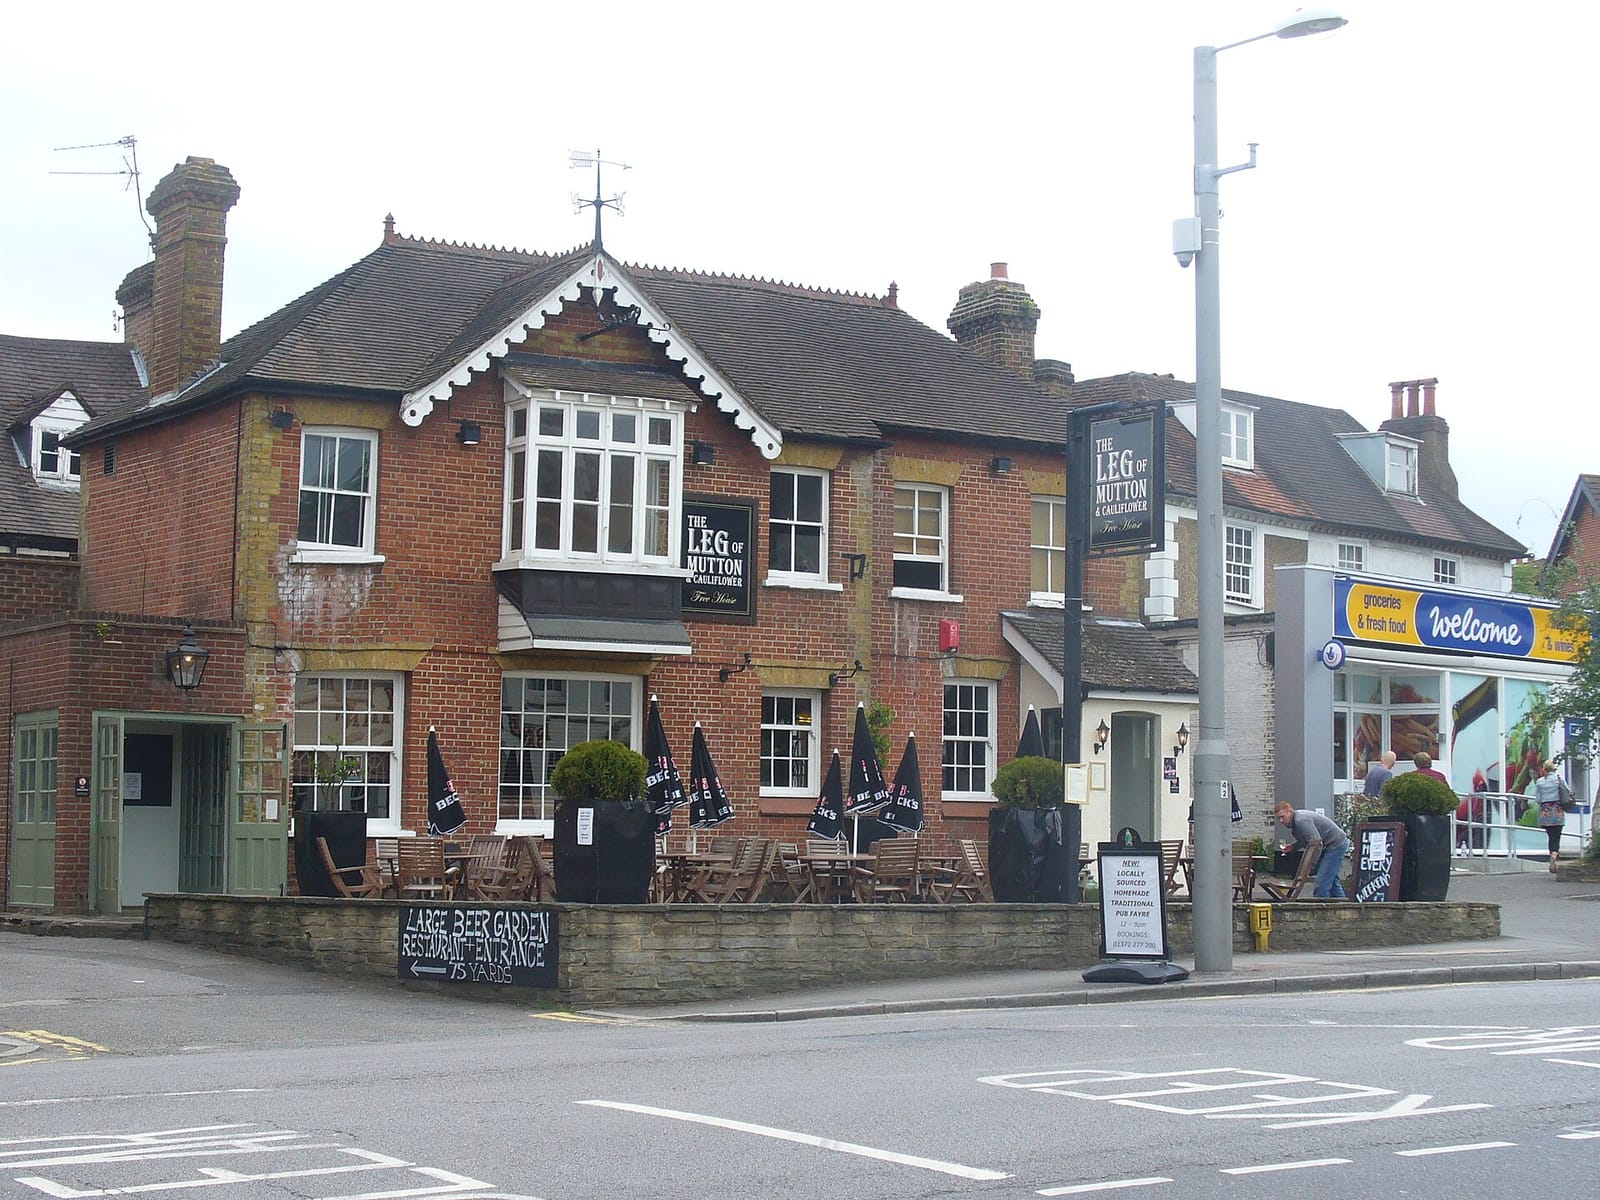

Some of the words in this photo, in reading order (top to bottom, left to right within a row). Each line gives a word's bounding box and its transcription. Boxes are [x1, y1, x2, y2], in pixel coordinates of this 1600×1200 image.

[1096, 437, 1113, 453] THE
[1096, 449, 1134, 483] LEG
[1136, 458, 1148, 473] OF
[1095, 478, 1147, 504] MUTTON
[1095, 507, 1101, 517] &
[1102, 500, 1148, 516] CAULIFLOWER
[687, 515, 707, 528] THE
[1100, 520, 1118, 534] Free
[1119, 517, 1143, 532] House
[687, 528, 729, 557] LEG
[731, 542, 744, 554] OF
[687, 555, 743, 576] MUTTON
[693, 574, 743, 587] CAULIFLOWER
[690, 590, 710, 602] Free
[711, 591, 737, 605] House
[1364, 593, 1401, 610] groceries
[1357, 613, 1364, 629] &
[1366, 614, 1387, 632] fresh
[1389, 617, 1407, 634] food
[1360, 857, 1392, 874] EVERY
[1113, 889, 1150, 897] HOMEMADE
[1355, 872, 1391, 903] WEEKEND
[406, 908, 448, 935] LARGE
[452, 909, 491, 938] BEER
[494, 910, 550, 944] GARDEN
[1258, 909, 1269, 929] H
[401, 933, 466, 962] RESTAURANT
[475, 937, 546, 968] ENTRANCE
[449, 962, 467, 980] 75
[469, 962, 513, 984] YARDS
